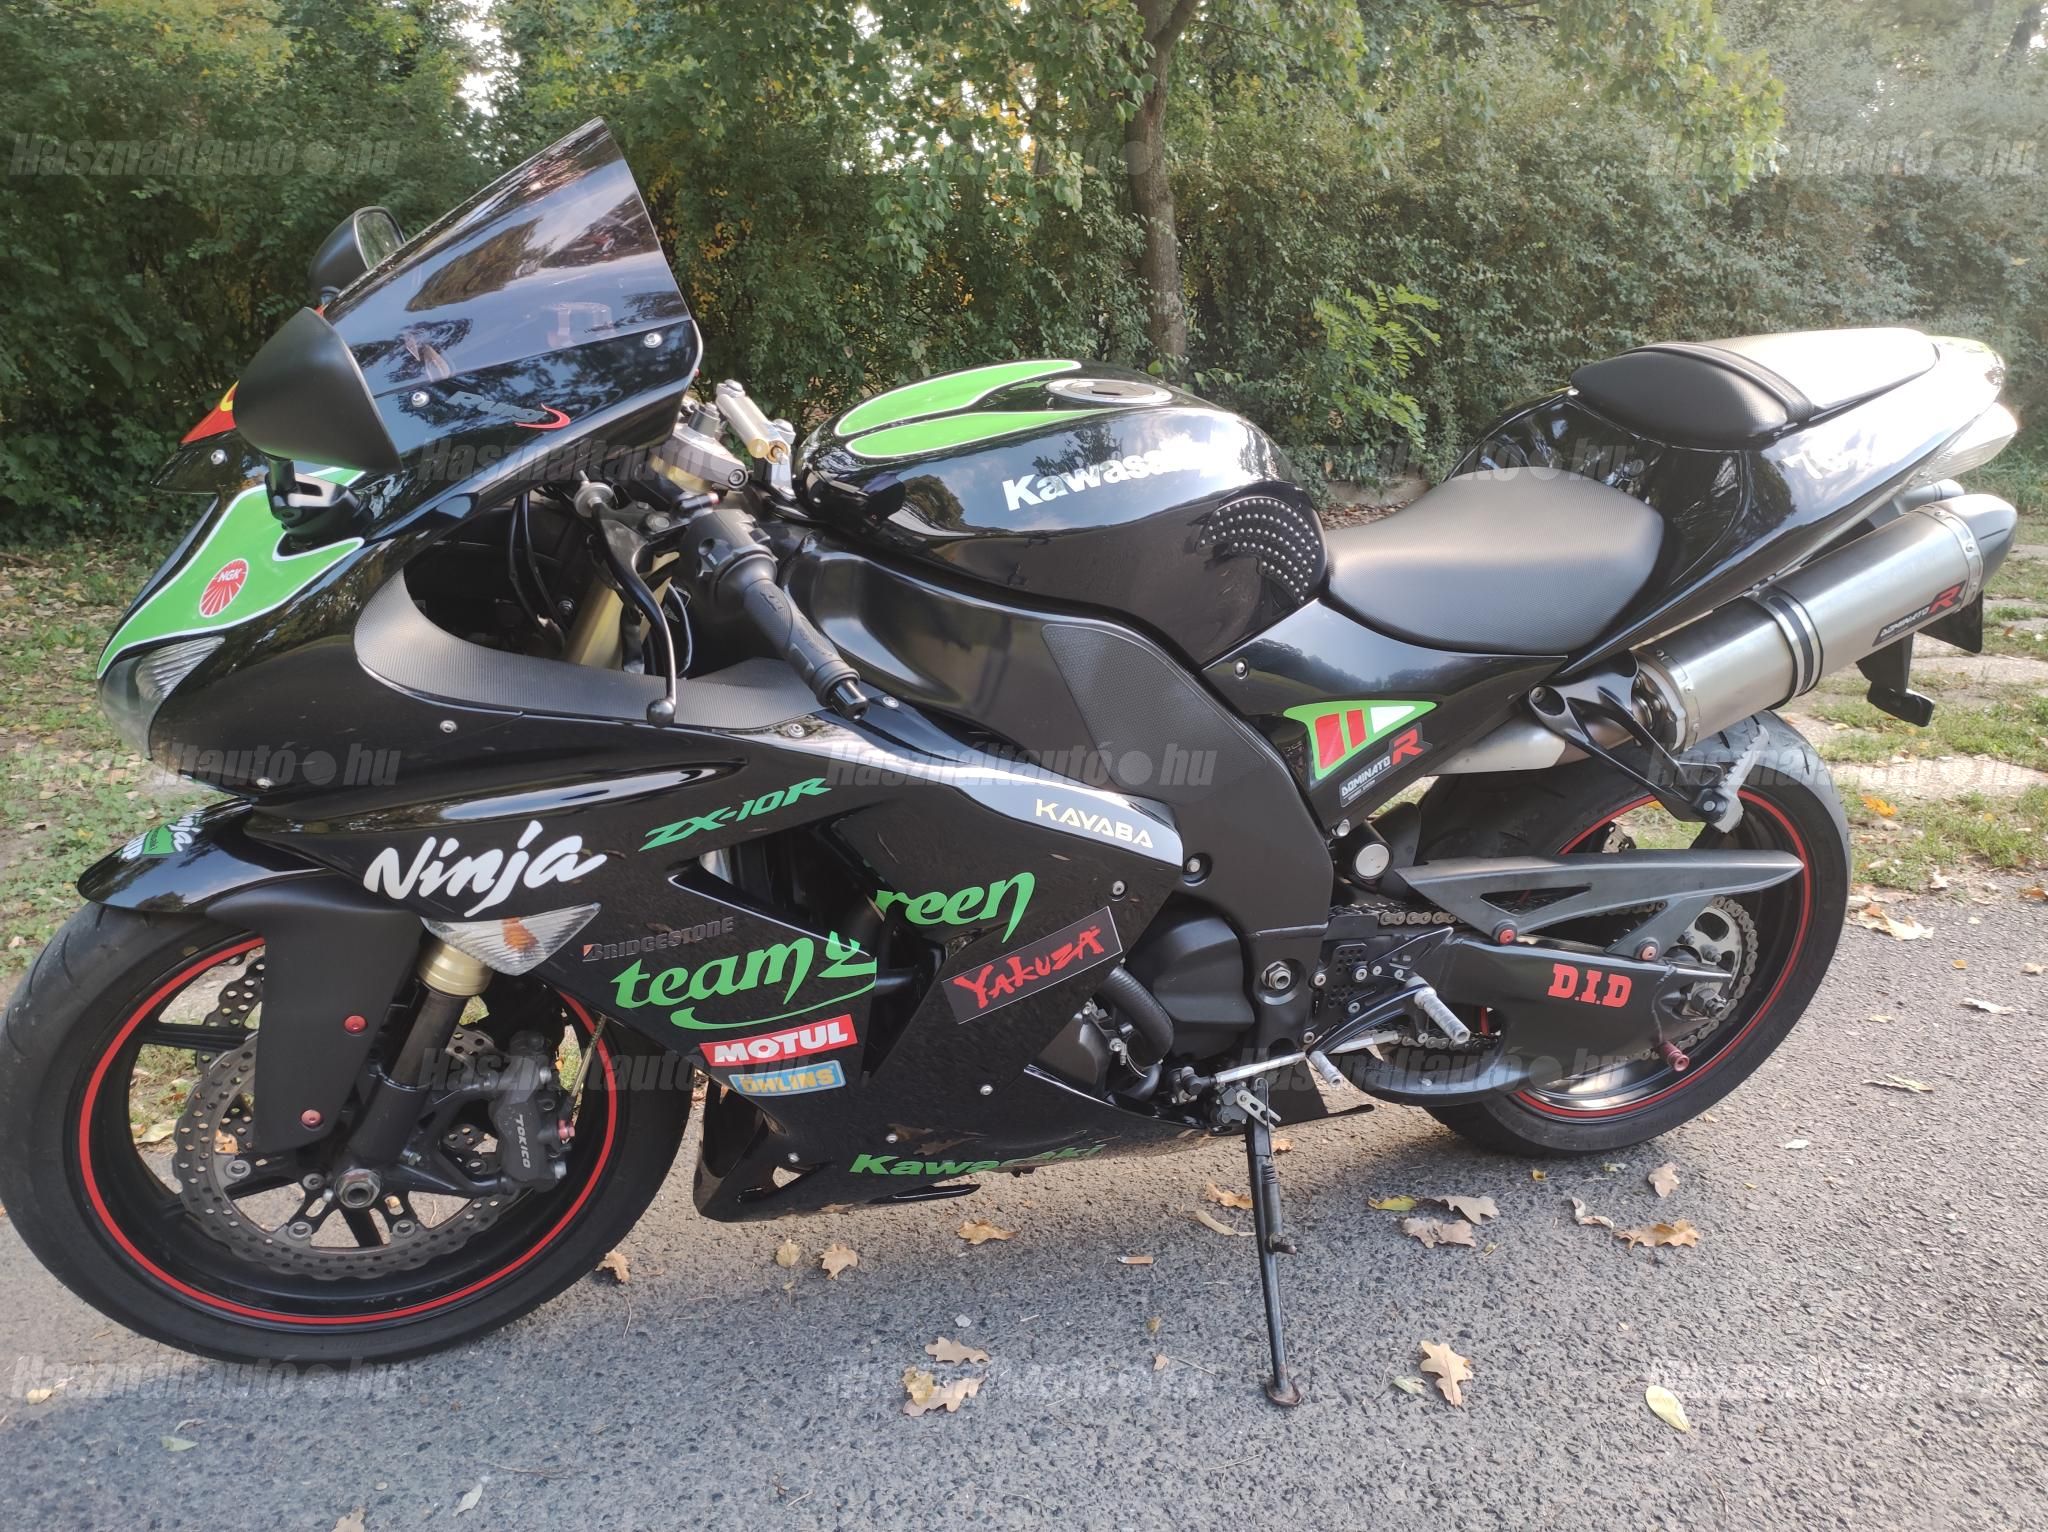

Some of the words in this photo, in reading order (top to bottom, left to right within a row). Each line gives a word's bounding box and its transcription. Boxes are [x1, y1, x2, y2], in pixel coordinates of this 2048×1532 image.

[1002, 446, 1205, 512] Kawasa
[216, 567, 243, 583] NGK
[638, 777, 833, 852] ZX-10R
[1035, 798, 1154, 849] KAYABA
[363, 820, 607, 918] Ninja
[582, 916, 735, 962] BRIDGESTONE
[610, 937, 814, 1009] team
[714, 1022, 849, 1063] MOTUL
[515, 1114, 531, 1169] TOKICO
